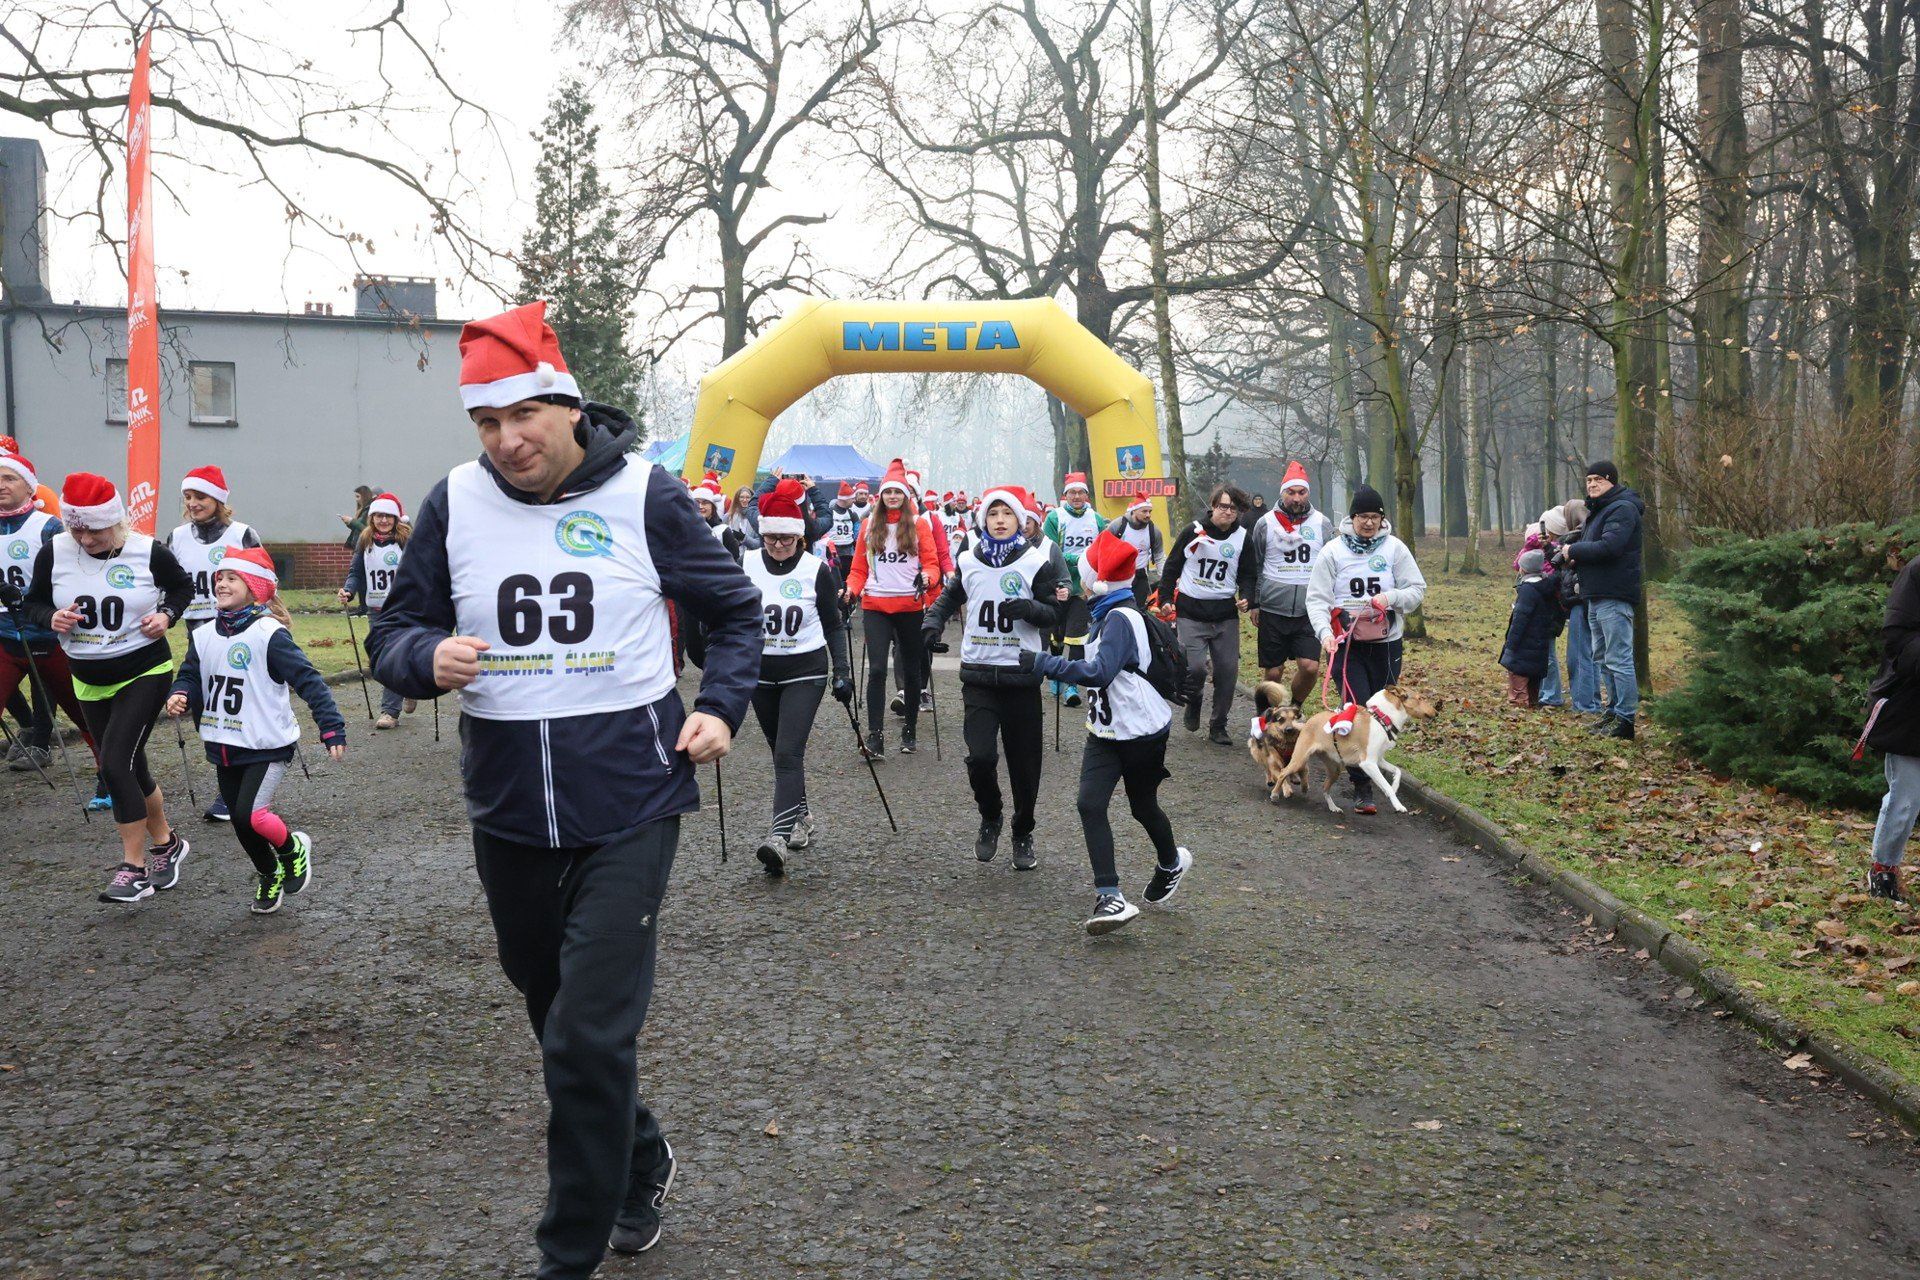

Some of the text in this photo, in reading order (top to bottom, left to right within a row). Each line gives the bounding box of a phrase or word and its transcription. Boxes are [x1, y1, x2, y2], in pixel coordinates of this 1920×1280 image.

[843, 321, 1020, 351] META
[836, 525, 849, 536] 59
[1065, 536, 1094, 548] 326
[877, 551, 908, 564] 492
[0, 565, 26, 588] 6
[369, 569, 395, 591] 131
[1197, 557, 1229, 582] 173
[1349, 576, 1382, 599] 95
[74, 594, 125, 632] 30
[497, 571, 594, 647] 63
[762, 603, 804, 637] 30
